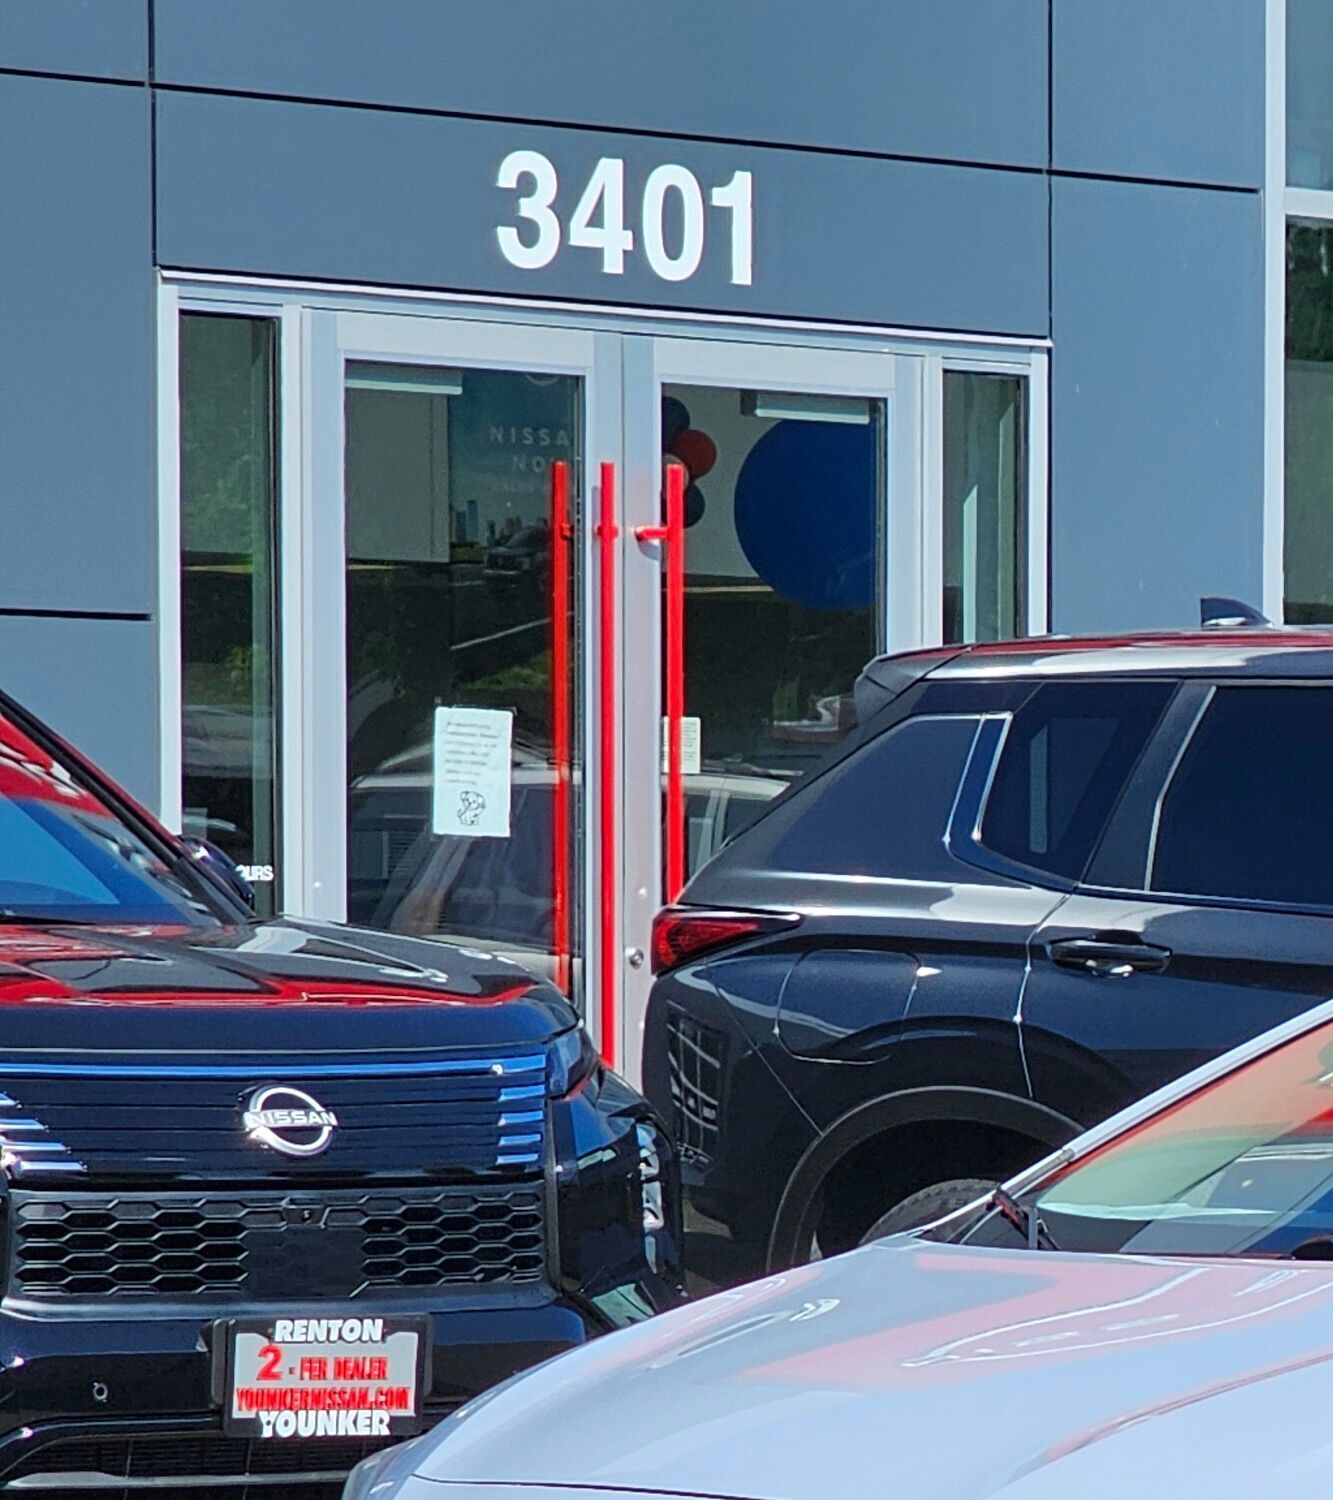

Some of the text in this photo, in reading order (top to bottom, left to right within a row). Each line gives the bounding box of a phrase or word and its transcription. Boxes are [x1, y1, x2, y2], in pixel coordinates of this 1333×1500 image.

[495, 150, 752, 286] 3401
[489, 425, 570, 447] NISSA
[235, 864, 274, 882] OURS
[243, 1110, 338, 1129] NISSAN
[273, 1318, 384, 1343] RENTON
[256, 1344, 283, 1381] 2
[299, 1356, 328, 1381] FER
[333, 1356, 389, 1381] DEALER
[236, 1387, 410, 1411] YOUNKERNISSAN.COM
[258, 1409, 391, 1438] YOUNKER
